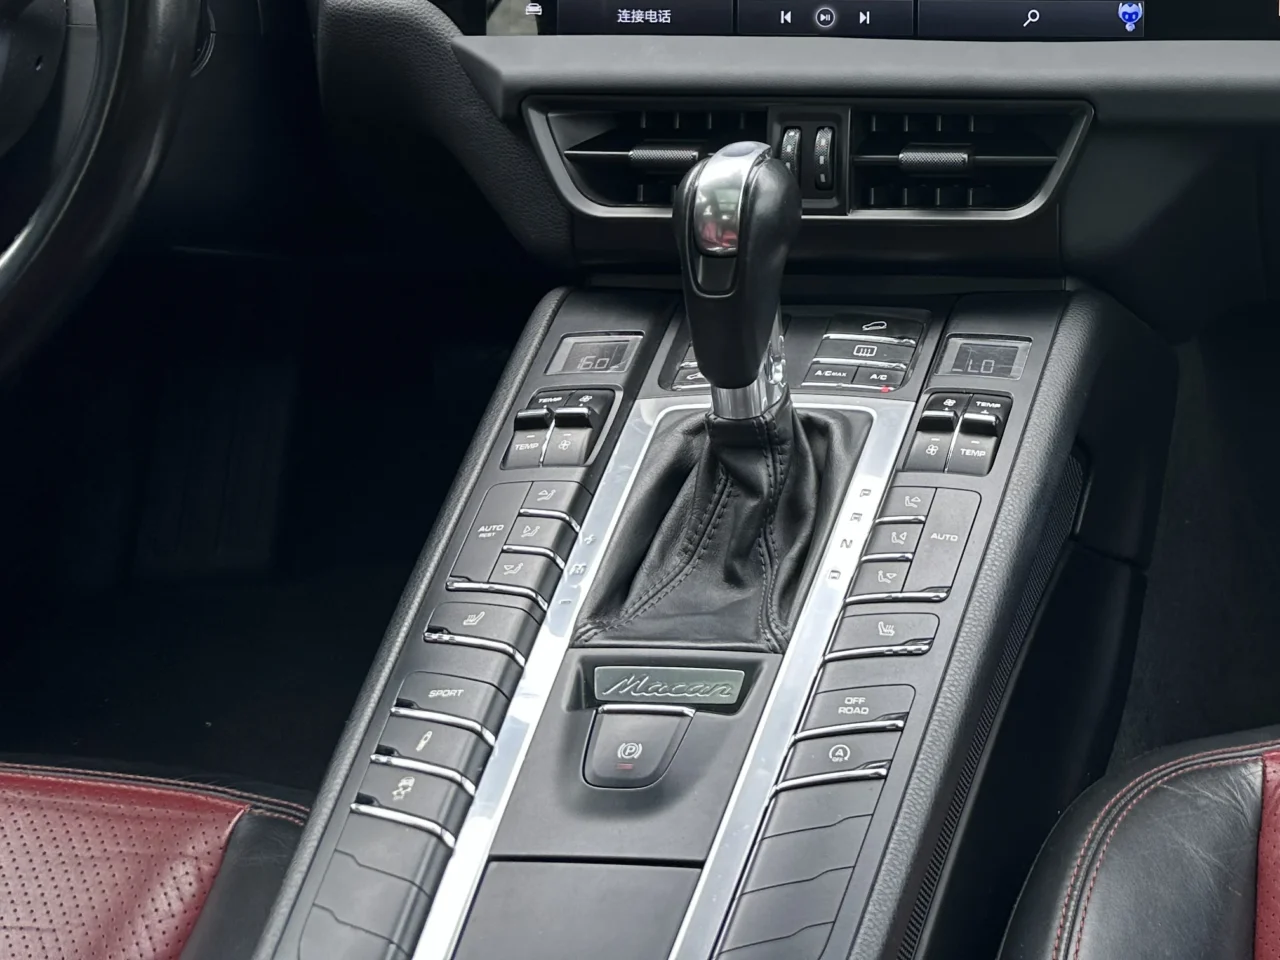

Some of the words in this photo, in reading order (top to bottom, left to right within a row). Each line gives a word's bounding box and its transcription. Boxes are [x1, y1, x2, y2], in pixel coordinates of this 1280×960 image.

[617, 9, 671, 24] 连接电话
[870, 373, 887, 381] A/C
[538, 396, 563, 404] TEMP
[976, 400, 1001, 409] TEMP
[515, 442, 539, 451] TEMP
[960, 448, 986, 458] TEMP
[478, 524, 504, 533] AUTO
[930, 532, 958, 542] AUTO
[602, 672, 733, 698] Macan
[428, 688, 464, 698] SPORT
[845, 696, 866, 705] OFF
[838, 706, 869, 715] ROAD
